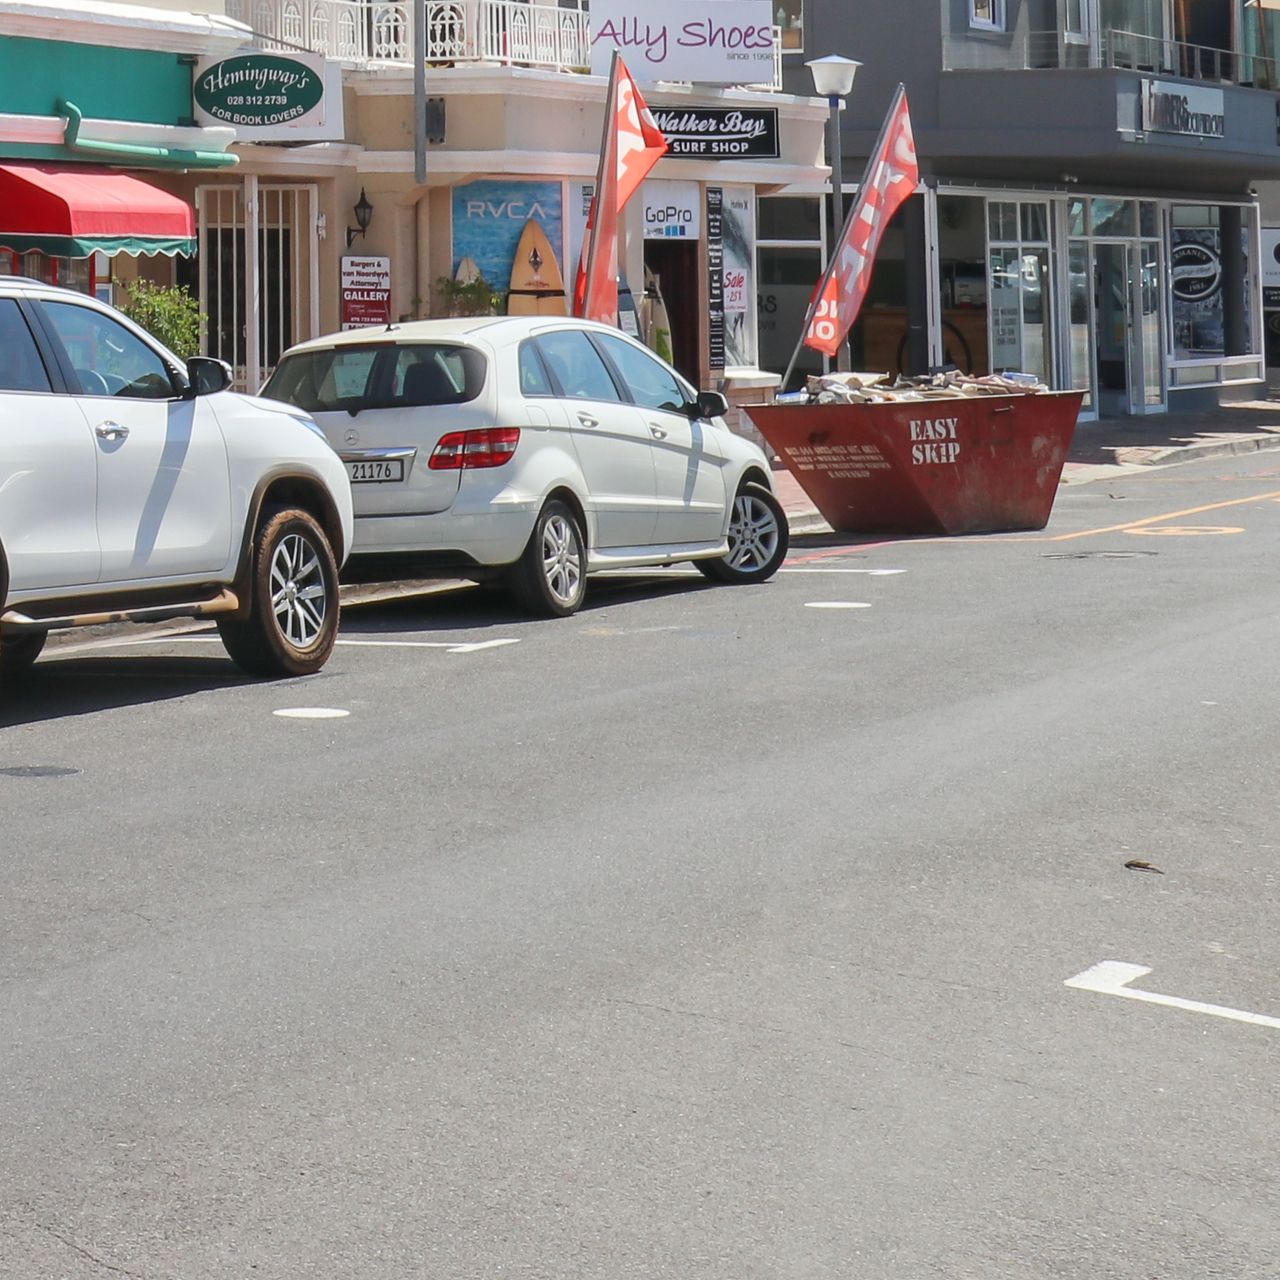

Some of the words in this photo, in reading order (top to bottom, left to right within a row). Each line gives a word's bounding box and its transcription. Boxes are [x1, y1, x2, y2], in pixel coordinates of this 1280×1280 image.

[590, 15, 668, 64] Ally
[676, 17, 774, 50] Shoes
[726, 52, 750, 61] since
[203, 60, 310, 94] Hemingway's
[227, 95, 244, 106] 028
[245, 95, 262, 106] 312
[264, 94, 288, 106] 2739
[210, 105, 232, 122] FOR
[233, 112, 263, 125] BOOK
[263, 104, 305, 125] LOVERS
[650, 111, 718, 133] Walker
[719, 110, 767, 139] Bay
[673, 141, 707, 153] SURF
[711, 141, 749, 153] SHOP
[466, 201, 546, 220] RVCA
[645, 206, 693, 223] GoPro
[342, 270, 355, 278] van
[723, 271, 745, 289] Sale
[343, 290, 390, 301] GALLERY
[908, 417, 959, 441] EASY
[911, 441, 961, 465] SKIP
[352, 463, 392, 480] 21176
